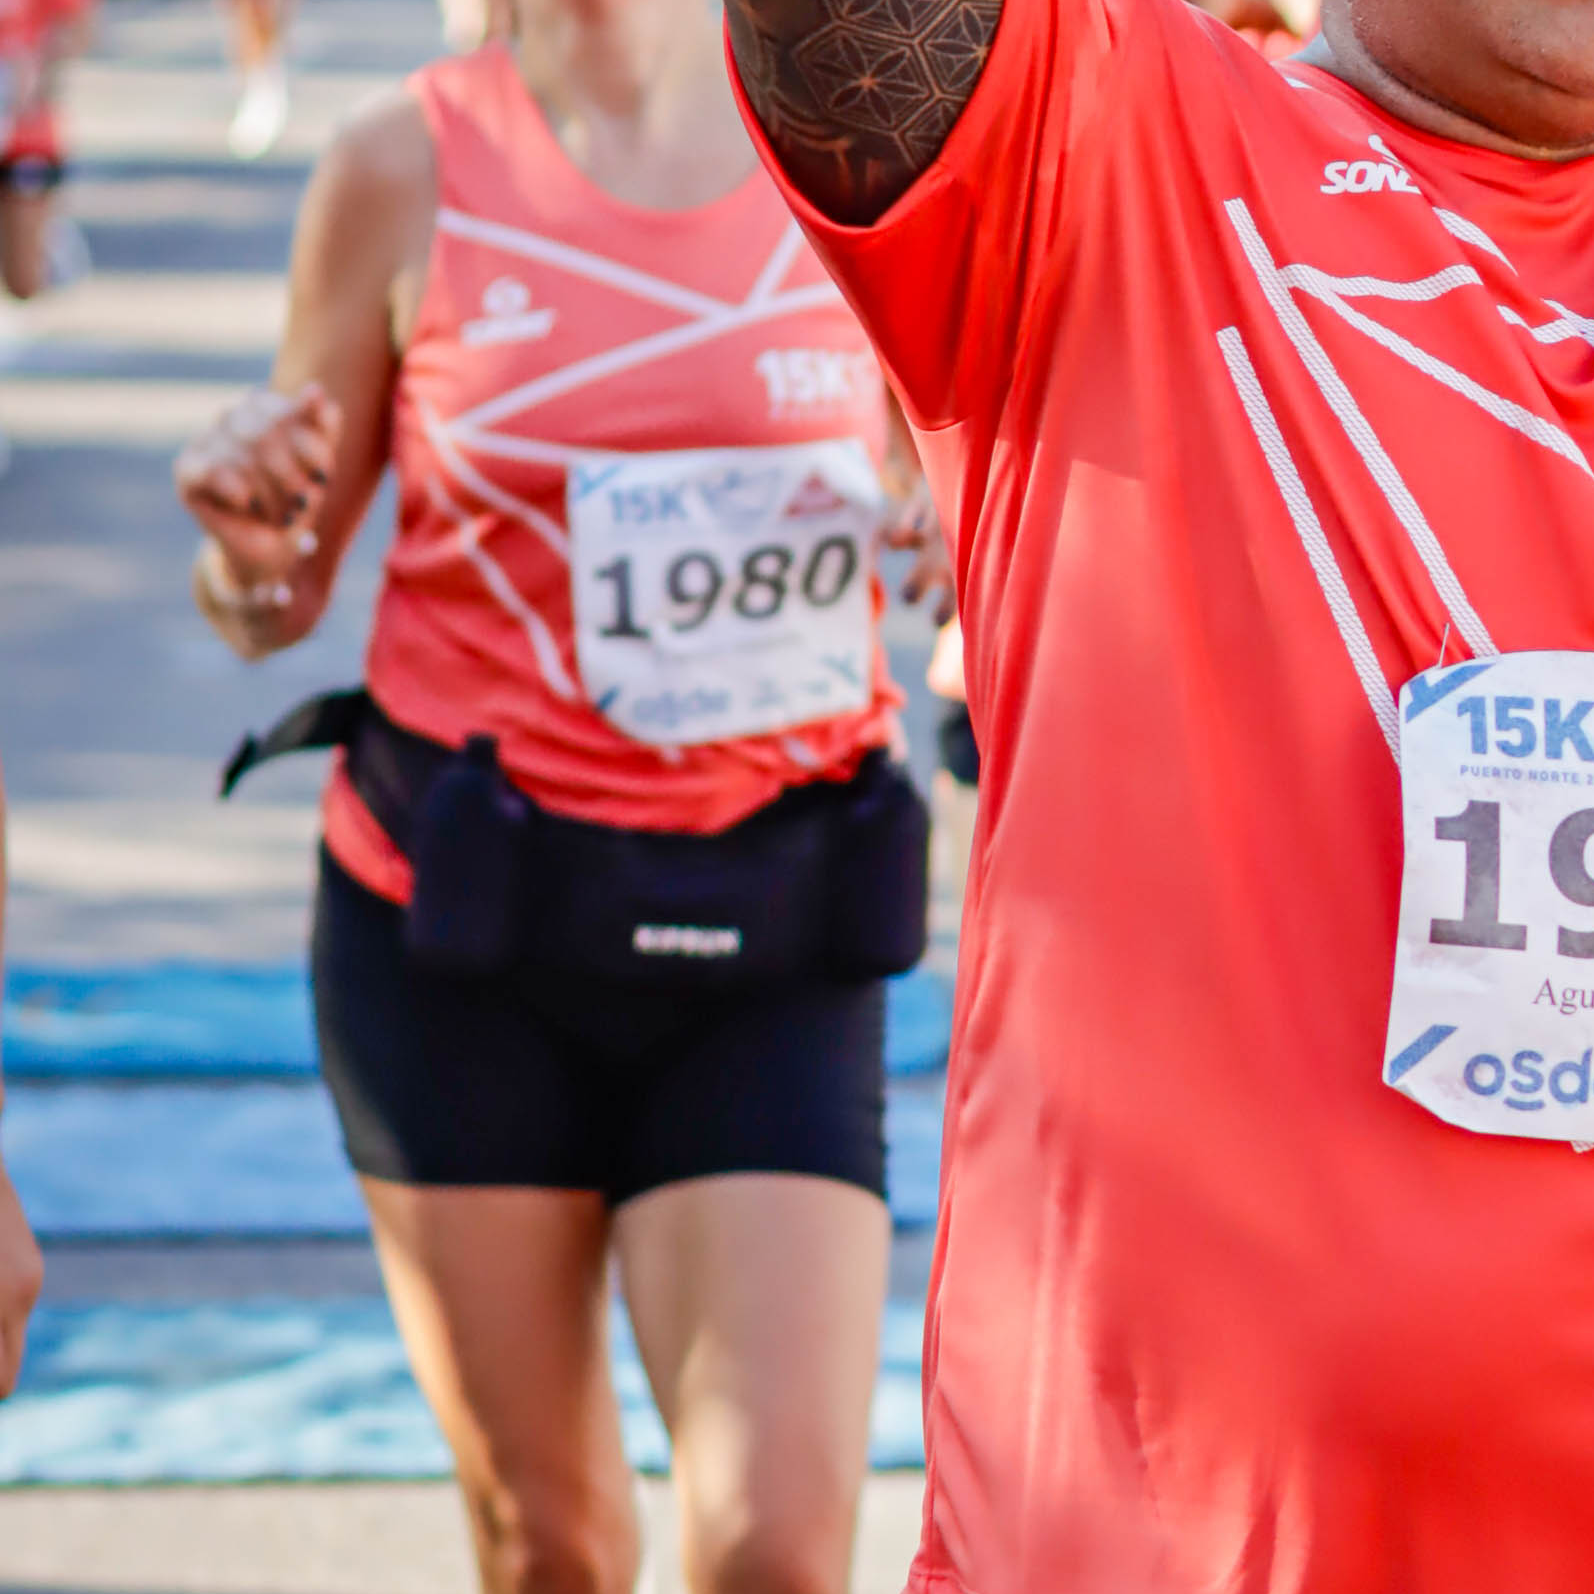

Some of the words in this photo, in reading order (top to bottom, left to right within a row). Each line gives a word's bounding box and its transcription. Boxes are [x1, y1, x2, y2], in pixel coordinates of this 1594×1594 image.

[594, 534, 858, 639] 1980
[1459, 764, 1523, 781] PUERTO
[1528, 770, 1581, 785] NORTE
